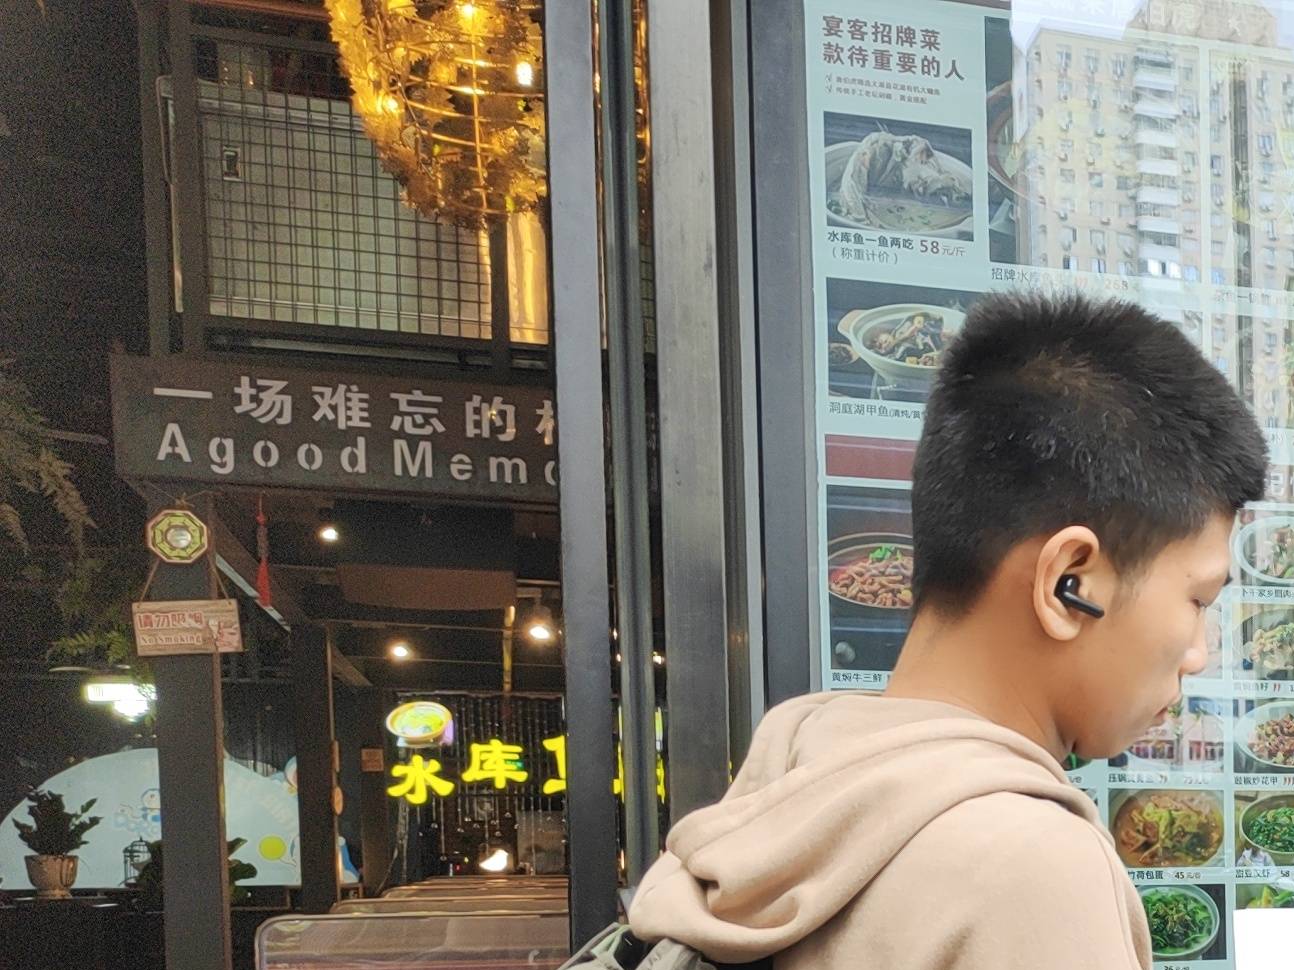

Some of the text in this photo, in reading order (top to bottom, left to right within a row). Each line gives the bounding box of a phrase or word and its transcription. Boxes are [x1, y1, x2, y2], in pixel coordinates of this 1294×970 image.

[823, 16, 941, 51] 宴客招牌菜
[823, 41, 965, 81] 款待重要的人
[828, 231, 914, 250] 水库鱼一鱼两吃
